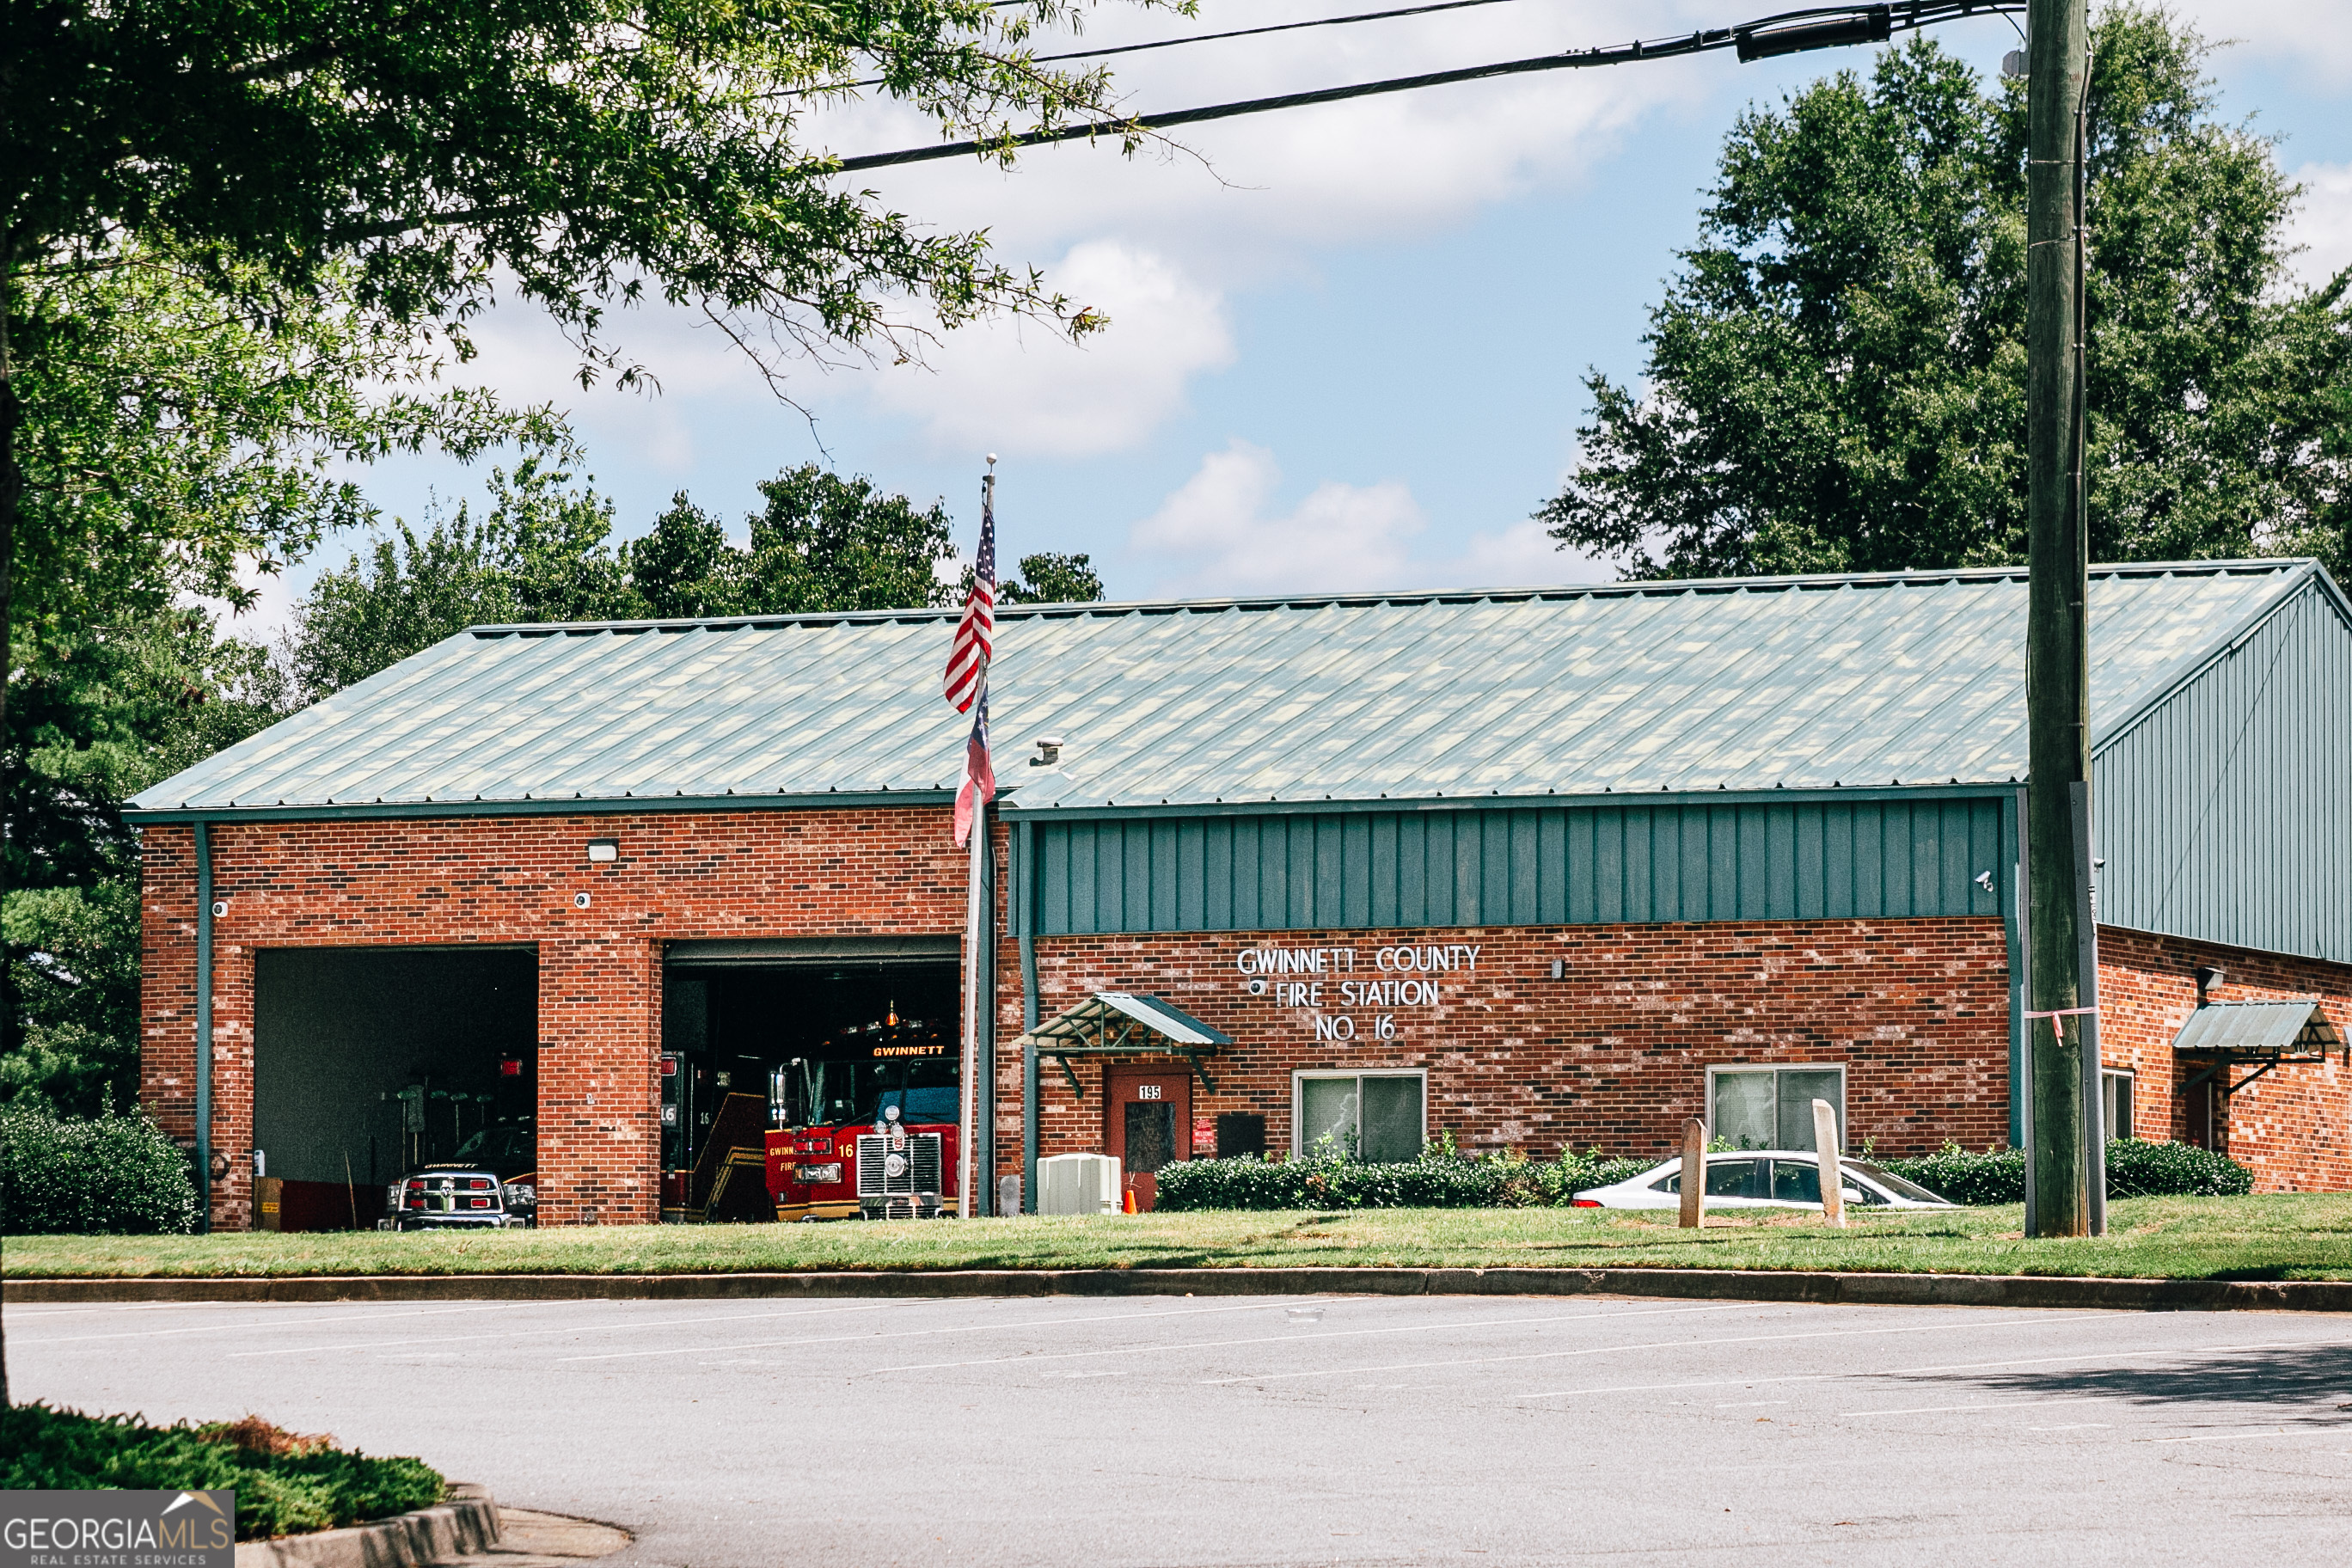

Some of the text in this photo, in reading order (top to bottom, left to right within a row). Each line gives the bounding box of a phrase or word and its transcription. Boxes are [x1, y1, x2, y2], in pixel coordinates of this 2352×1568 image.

[1237, 945, 1481, 975] GWINNETT COUNTY
[1277, 980, 1439, 1008] FIRE STATION
[1316, 1014, 1395, 1041] NO. 16
[873, 1045, 945, 1057] GWINNETT
[1141, 1086, 1160, 1099] 195
[700, 1112, 709, 1124] 16
[769, 1146, 793, 1156] GWINN
[838, 1143, 854, 1158] 16
